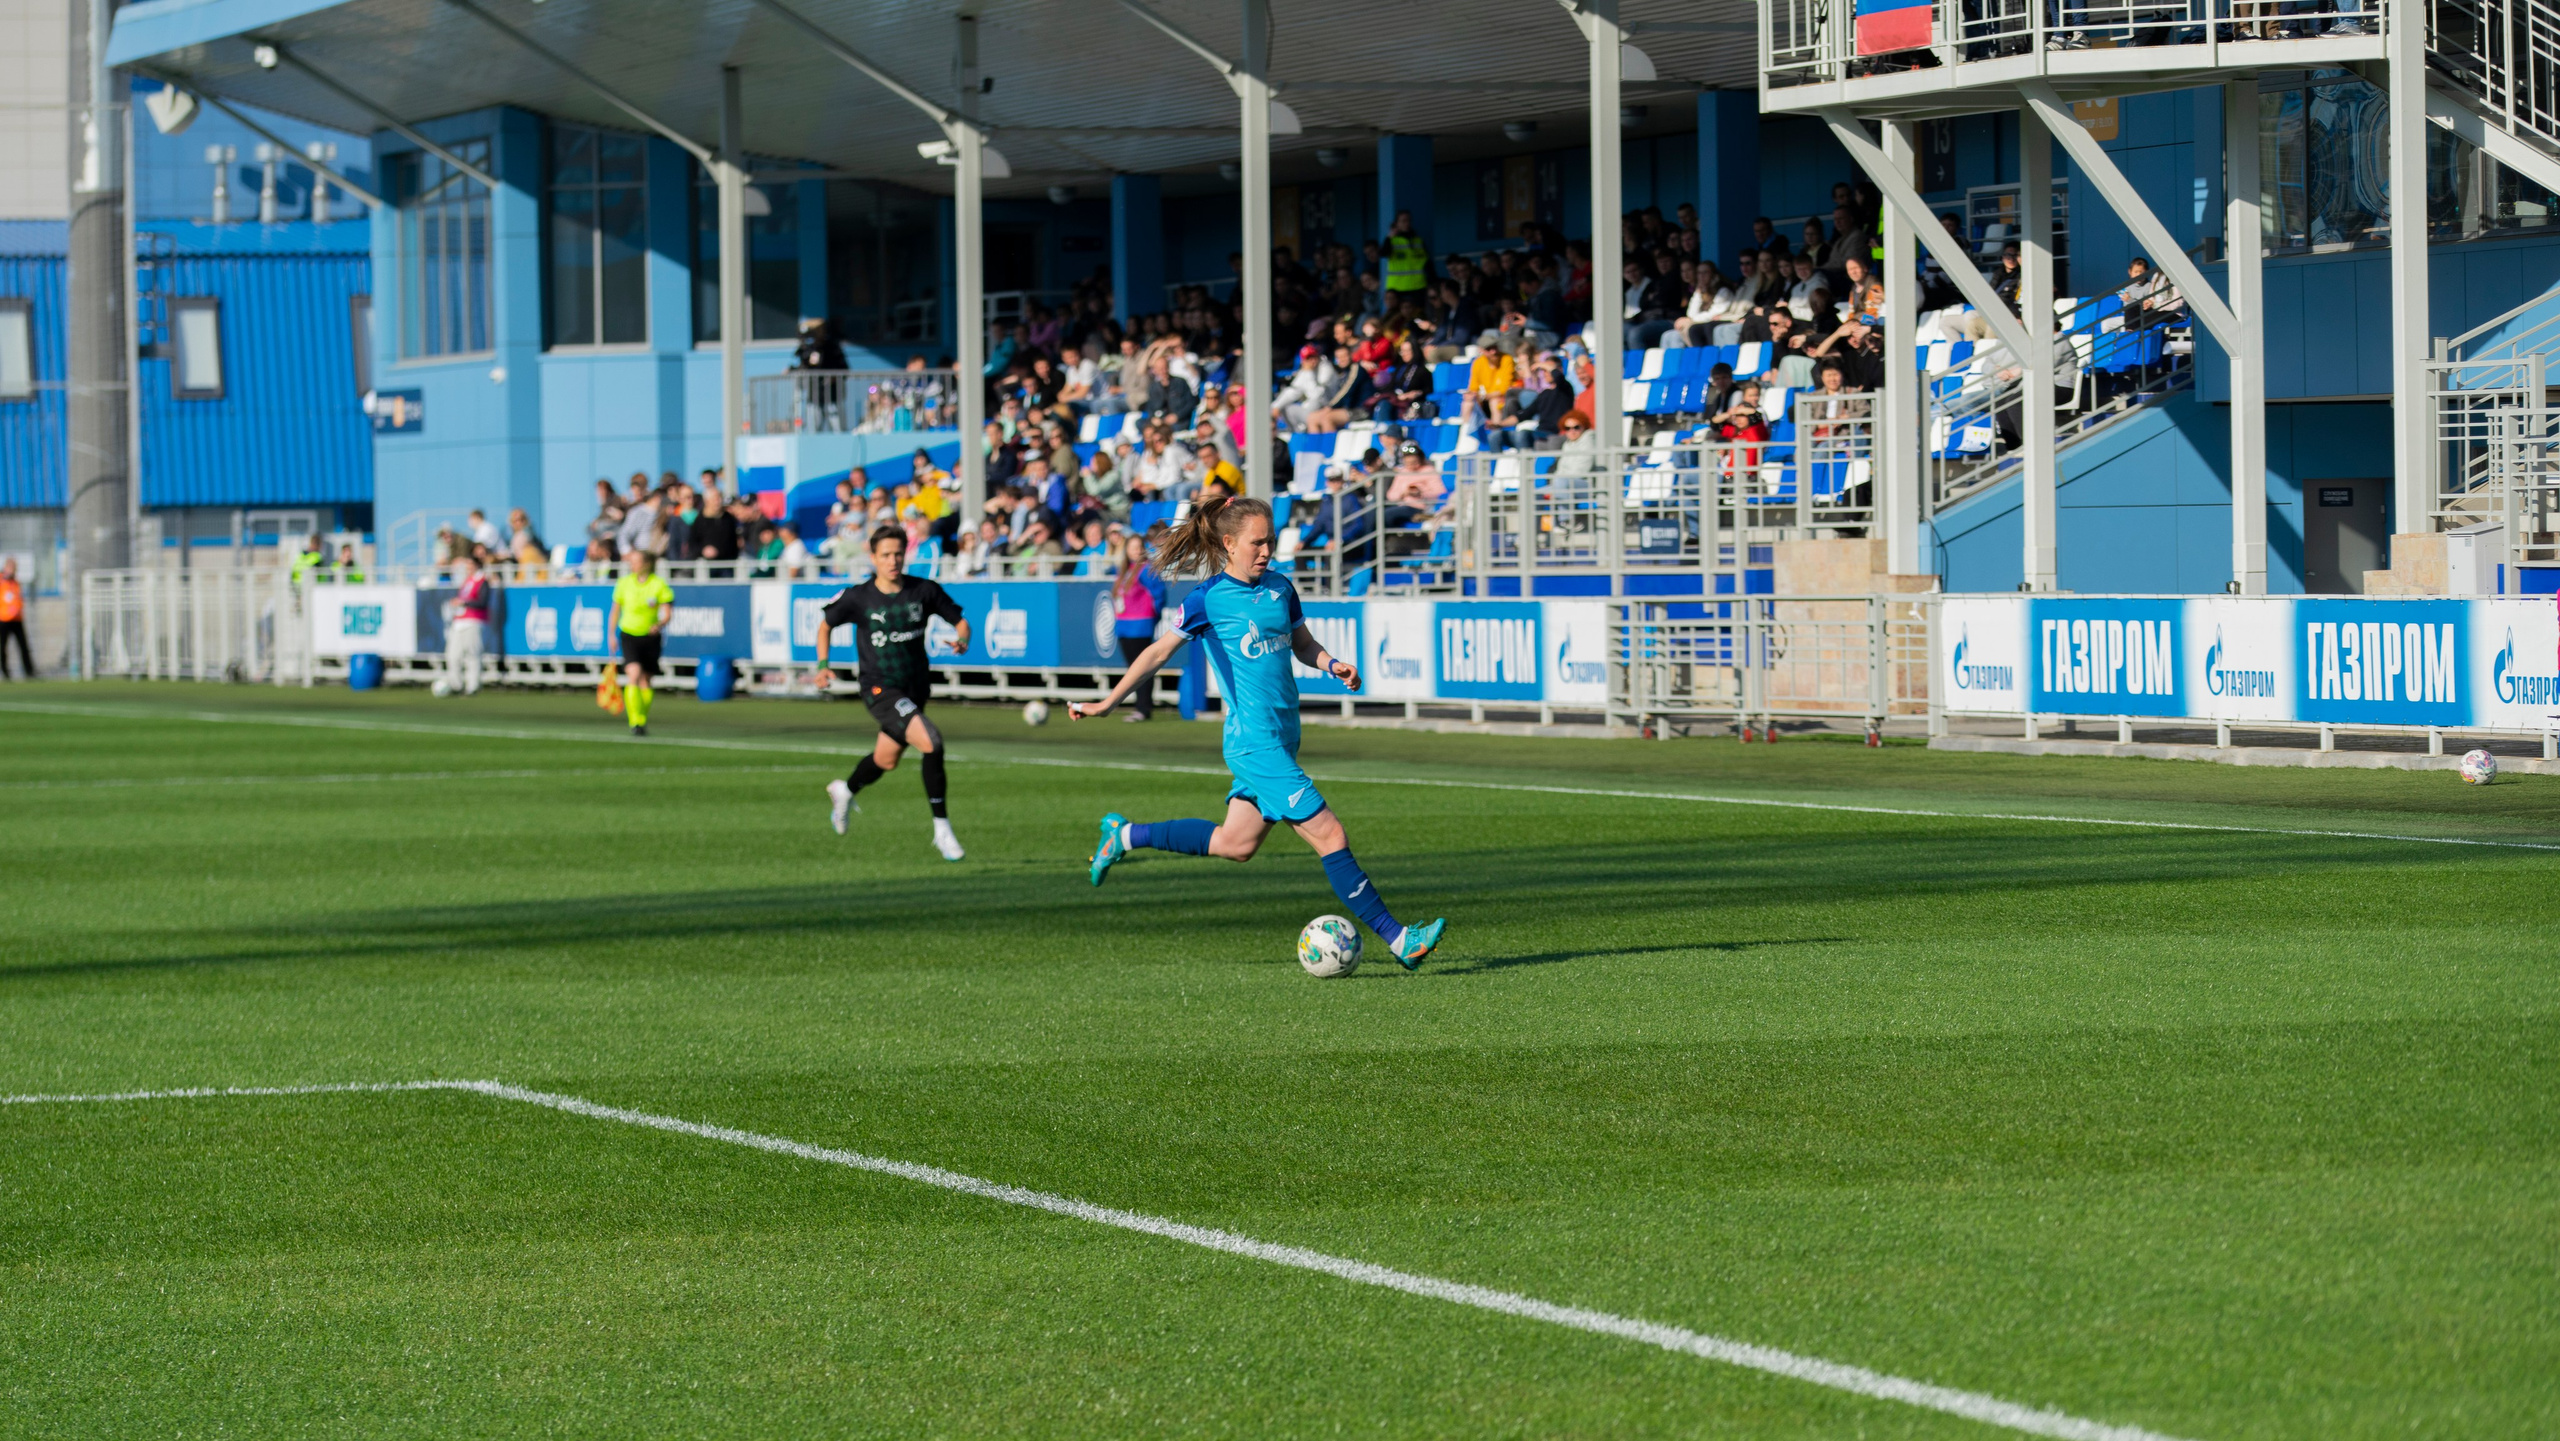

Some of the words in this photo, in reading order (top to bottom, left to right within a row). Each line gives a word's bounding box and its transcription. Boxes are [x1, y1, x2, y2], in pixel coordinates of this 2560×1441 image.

[1930, 118, 1950, 154] 13
[1441, 618, 1537, 683] ГАЗПРОМ
[2042, 619, 2173, 695] ГАЗПРОМ
[2307, 622, 2456, 702] ГАЗПРОМ
[1970, 666, 2013, 690] ГАЗПРОМ
[2225, 670, 2275, 697] ГАЗПРОМ
[2516, 676, 2559, 705] ГАЗПРО
